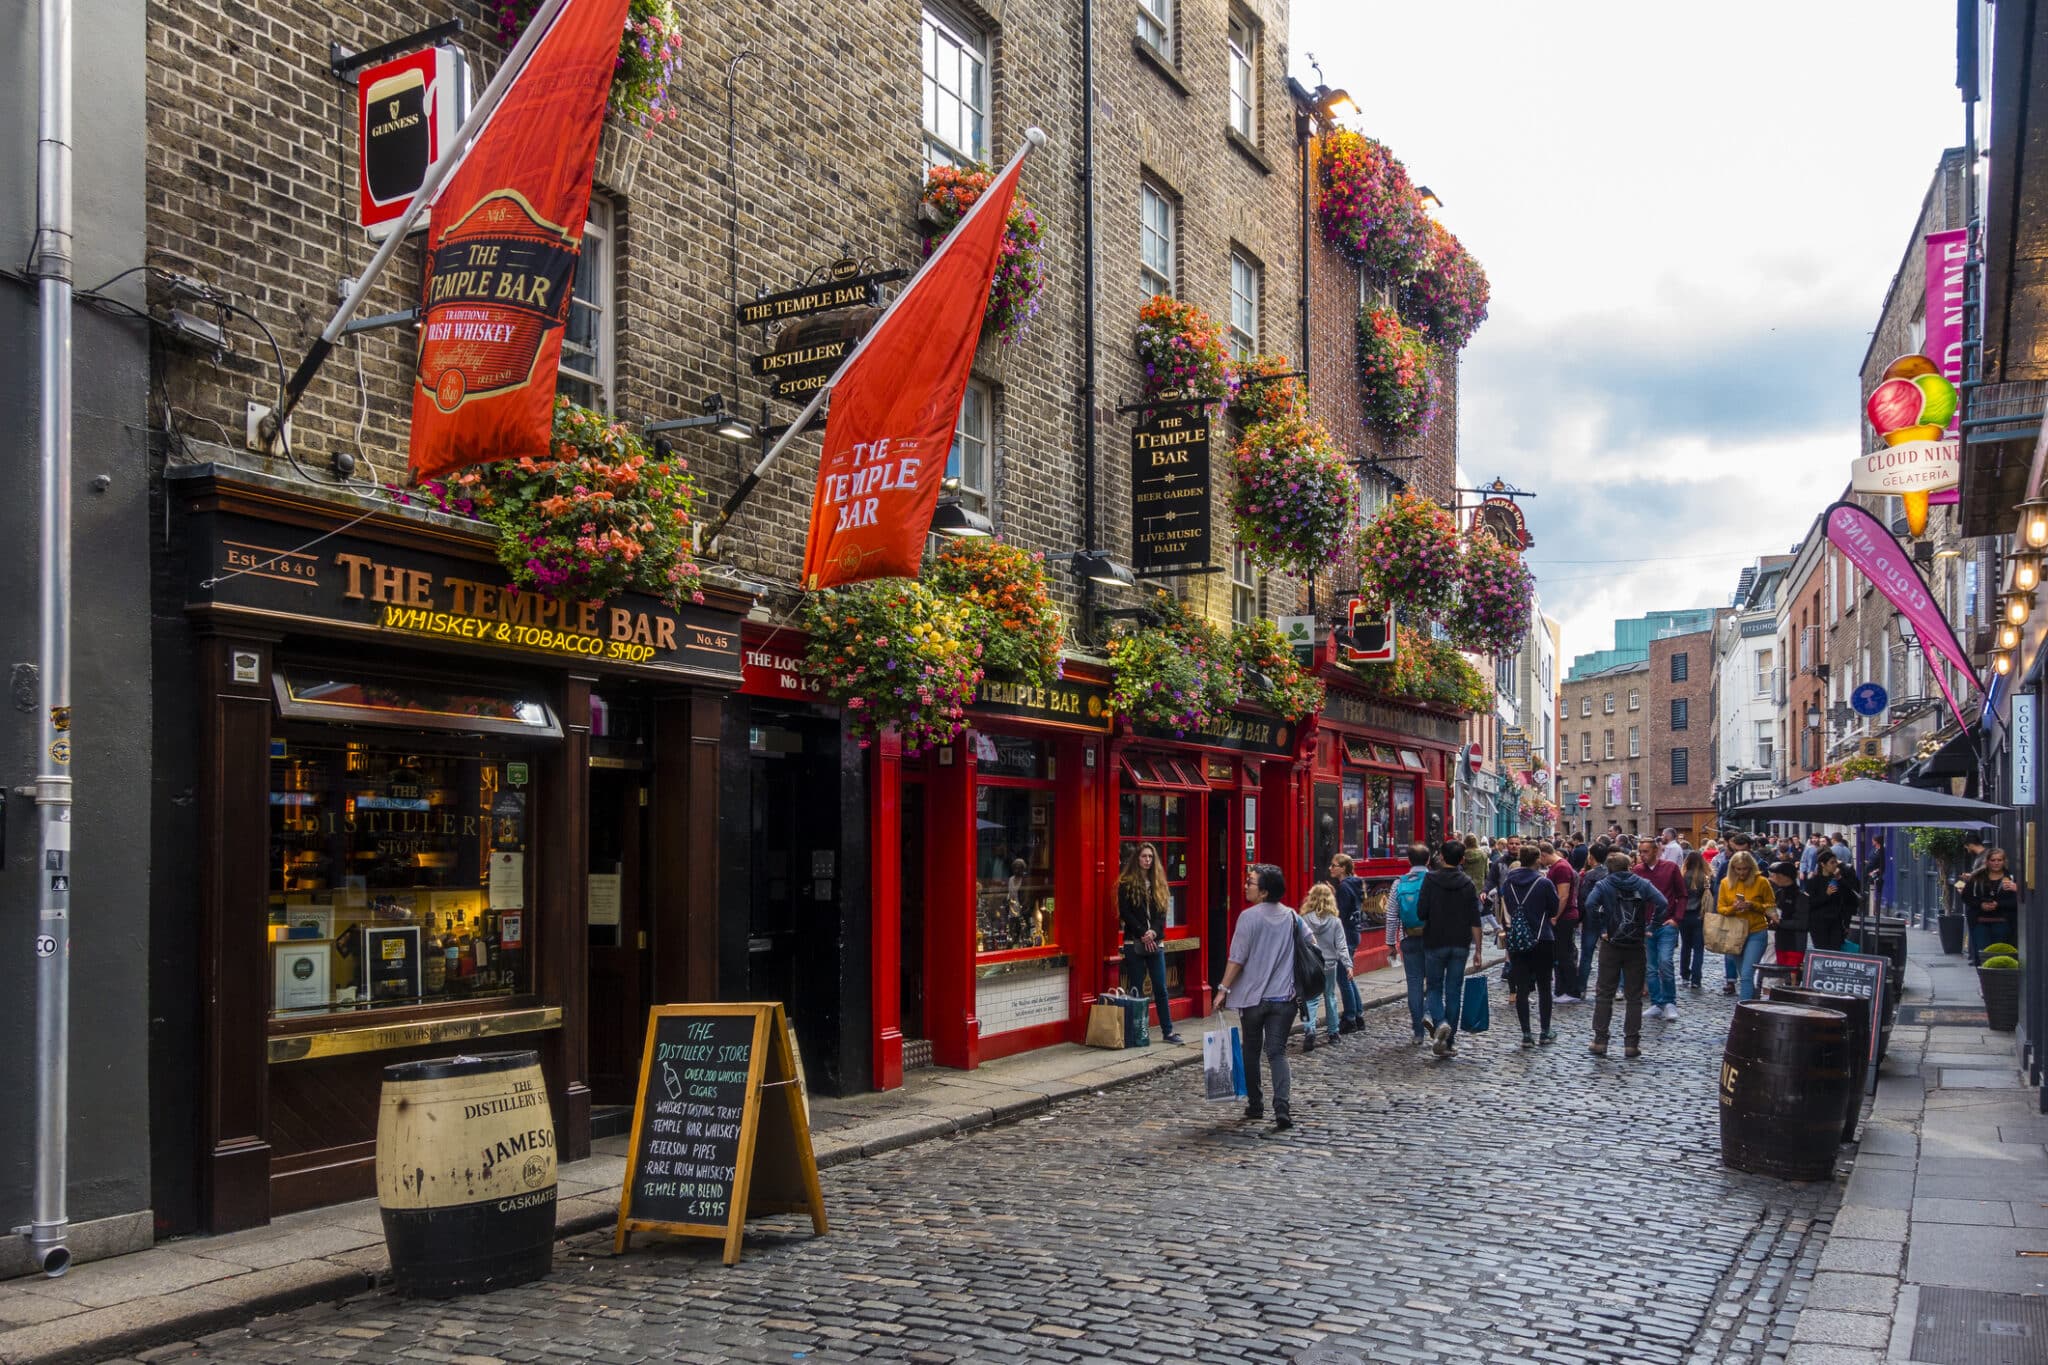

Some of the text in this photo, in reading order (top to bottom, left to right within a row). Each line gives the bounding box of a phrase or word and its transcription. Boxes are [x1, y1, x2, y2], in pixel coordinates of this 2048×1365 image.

[372, 113, 419, 137] GUINNESS
[468, 244, 500, 266] THE
[430, 271, 551, 307] TEMPLE BAR
[744, 286, 866, 321] THE TEMPLE BAR
[446, 311, 489, 320] TRADITIONAL
[428, 323, 516, 343] IRISH WHISKEY
[762, 342, 845, 371] DISTILLERY
[779, 375, 827, 395] STORE
[1158, 417, 1183, 429] THE
[1135, 428, 1206, 449] TEMPLE
[1151, 450, 1189, 467] BAR
[1867, 451, 1918, 473] CLOUD
[824, 458, 921, 505] TEMPLE
[1882, 470, 1950, 487] GELATERIA
[1136, 487, 1204, 503] BEER GARDEN
[835, 497, 879, 532] BAR
[1139, 528, 1202, 543] LIVE MUSIC
[1154, 542, 1188, 553] DAILY
[270, 559, 316, 577] 1840
[335, 552, 678, 650] THE TEMPLE BAR
[385, 605, 656, 663] WHISKEY & TOBACCO SHOP
[696, 633, 728, 648] No. 45
[746, 651, 772, 667] THE
[781, 674, 820, 692] No 1-6
[980, 680, 1080, 714] TEMPLE BAR
[1202, 717, 1270, 744] EMPLE BAR
[2019, 705, 2029, 794] COCKTAILS
[392, 785, 418, 797] THE
[1812, 980, 1872, 996] COFFEE
[688, 1022, 715, 1040] THE
[658, 1043, 750, 1062] DISTILLERY STORE
[684, 1068, 704, 1081] OVER
[512, 1080, 532, 1093] THE
[689, 1084, 718, 1099] CIGARS
[464, 1092, 537, 1119] DISTILLERY
[717, 1106, 742, 1119] TRAYS
[686, 1121, 702, 1136] BAR
[705, 1123, 741, 1140] WHISKEY
[692, 1143, 716, 1160] PIPES
[674, 1162, 695, 1176] IRISH
[696, 1164, 736, 1181] WHISKEYS
[644, 1182, 724, 1199] TEMPLE BAR BLEND
